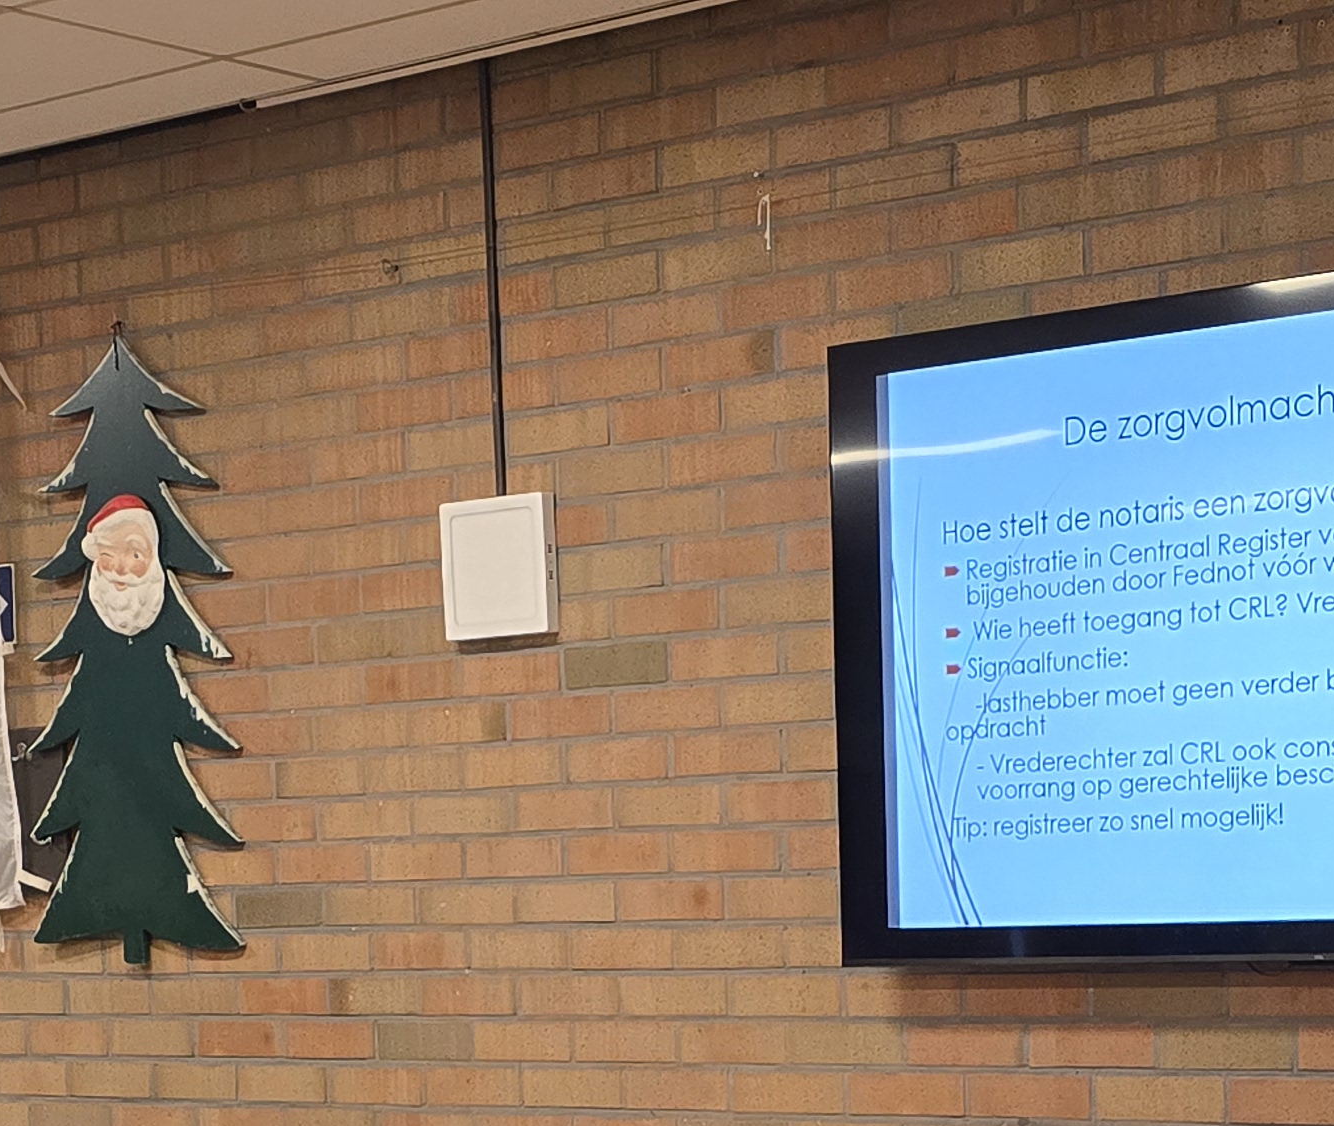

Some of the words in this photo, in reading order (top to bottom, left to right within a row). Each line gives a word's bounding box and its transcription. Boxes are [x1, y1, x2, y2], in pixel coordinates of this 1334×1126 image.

[1066, 416, 1107, 445] De
[943, 520, 991, 544] Hoe
[1000, 510, 1048, 539] stelt
[1057, 507, 1090, 532] de
[1100, 496, 1184, 528] notaris
[1194, 495, 1245, 518] een
[967, 550, 1077, 582] Registratie
[1084, 547, 1101, 569] in
[1110, 535, 1209, 565] Centraal
[1219, 528, 1311, 559] Register
[966, 574, 1105, 609] bijgehouden
[1113, 570, 1166, 591] door
[1174, 558, 1255, 586] Fednot
[1263, 552, 1317, 577] vóór
[973, 619, 1012, 641] Wie
[1019, 611, 1076, 638] heeft
[1083, 606, 1182, 634] toegang
[1190, 599, 1221, 623] tot
[1229, 594, 1287, 620] CRL?
[966, 647, 1129, 682] Signaalfunctie:
[975, 687, 1099, 714] -lasthebber
[1107, 680, 1165, 705] moet
[1173, 682, 1233, 706] geen
[1241, 671, 1319, 695] verder
[946, 715, 1046, 746] opdracht
[990, 747, 1136, 774] Vrederechter
[1143, 744, 1172, 766] zal
[1181, 741, 1225, 764] CRL
[1233, 738, 1276, 761] ook
[977, 781, 1075, 801] voorrang
[1083, 779, 1112, 800] op
[1120, 766, 1267, 799] gerechtelijke
[953, 816, 987, 843] Tip:
[994, 813, 1093, 840] registreer
[1100, 816, 1123, 832] zo
[1131, 808, 1173, 830] snel
[1182, 803, 1283, 832] mogelijk!
